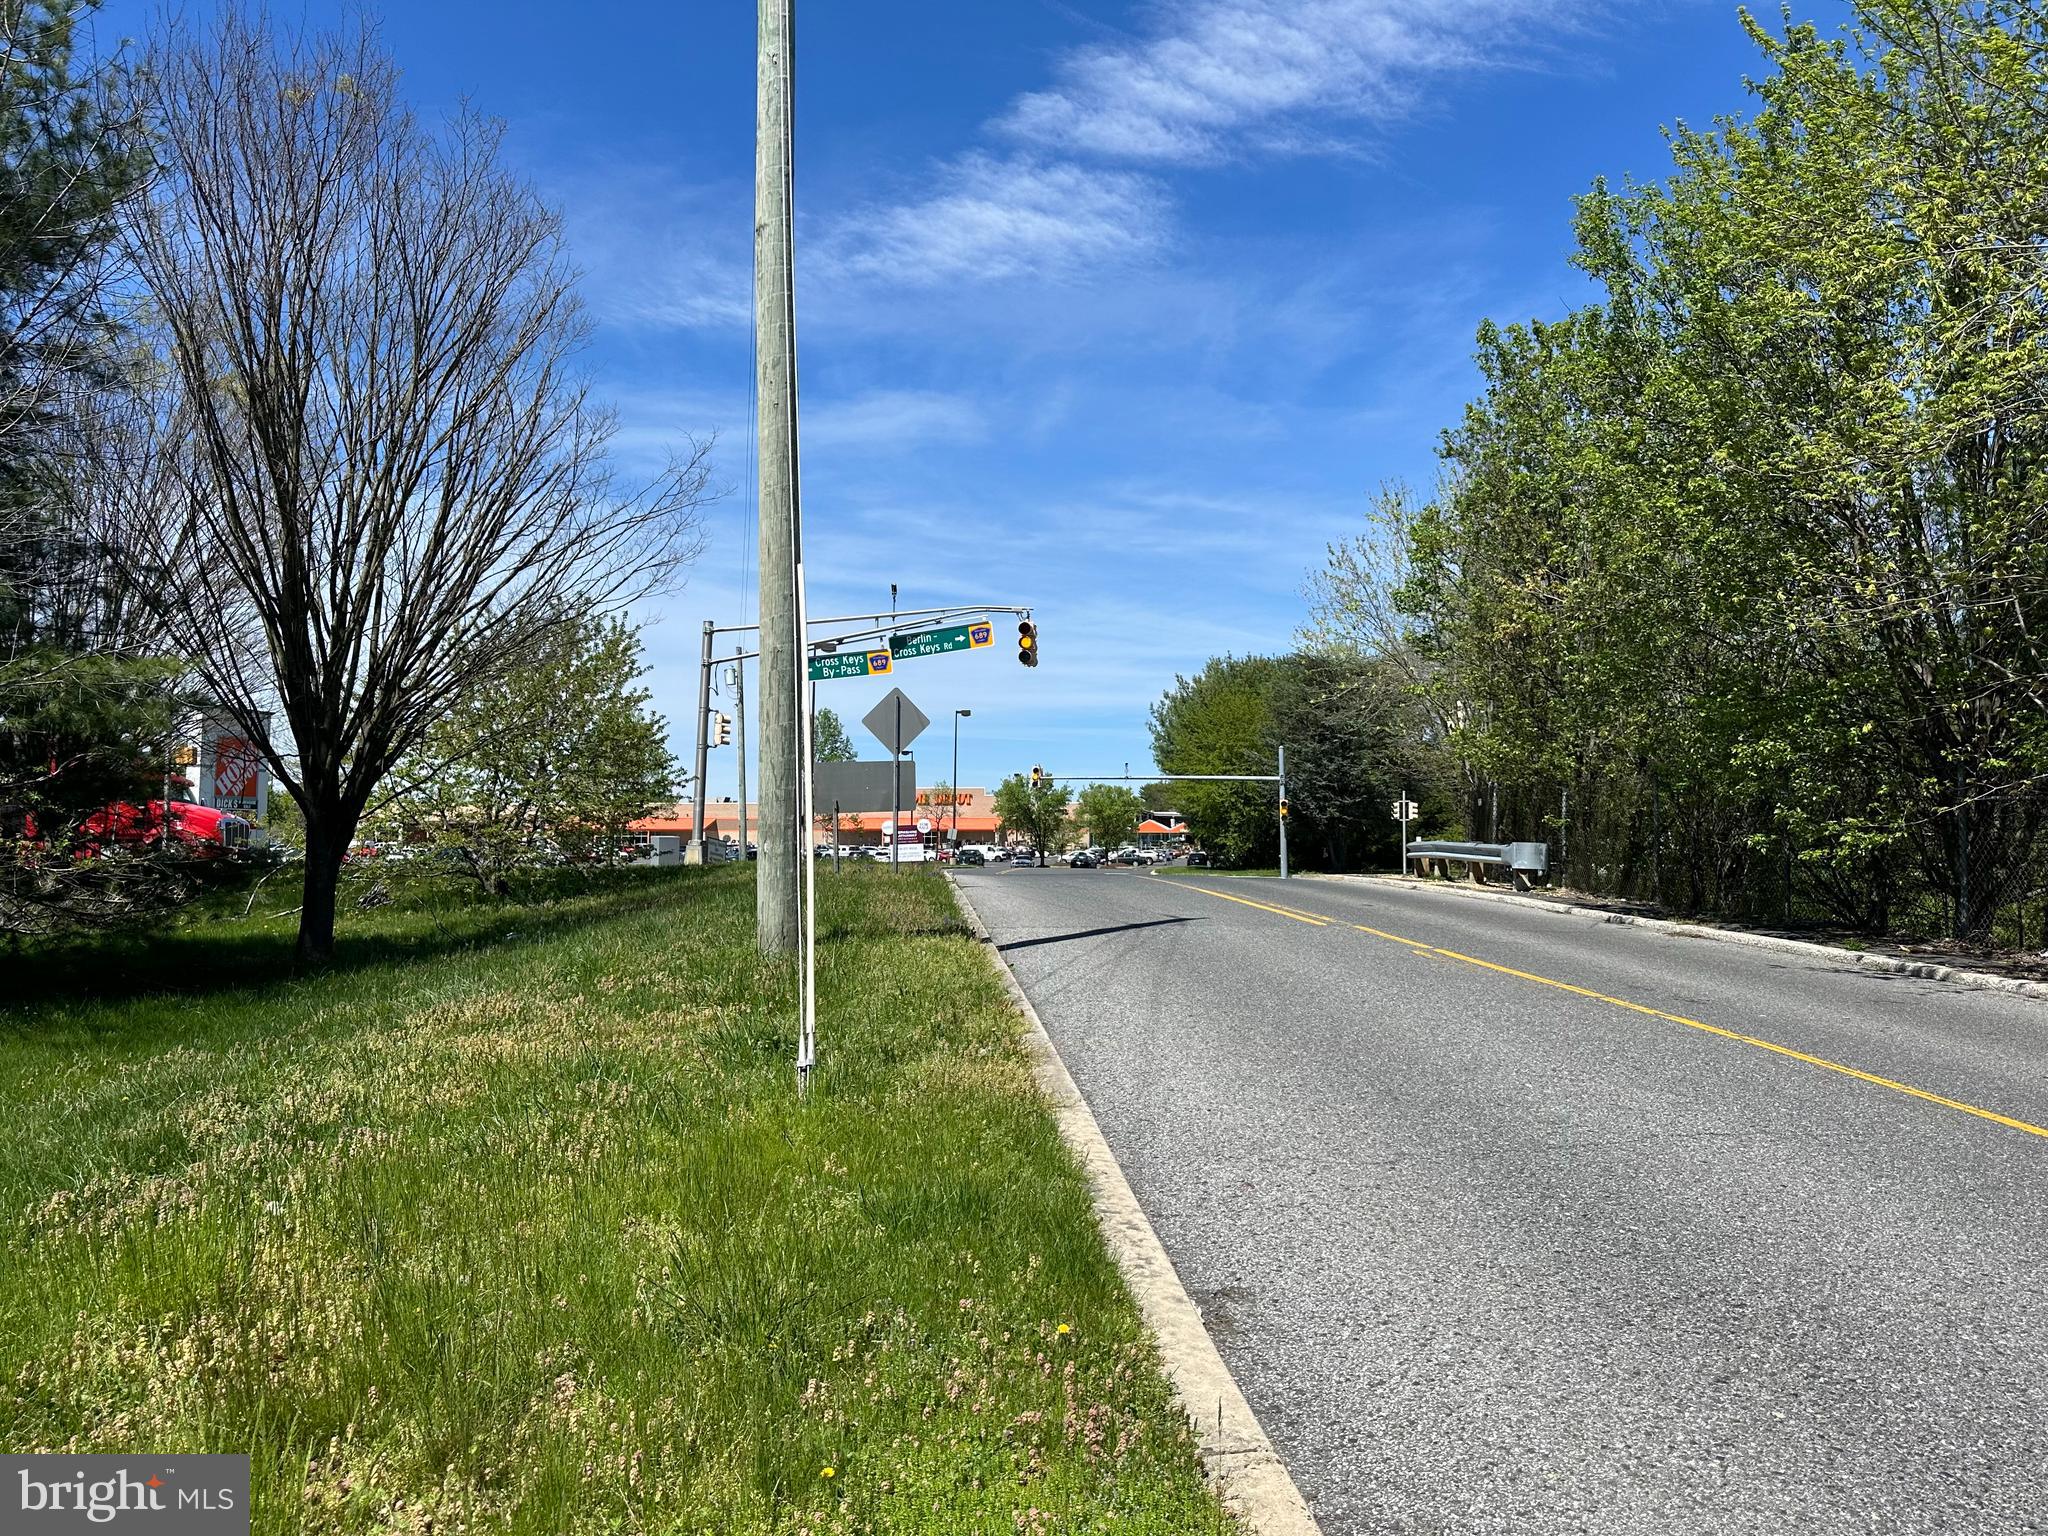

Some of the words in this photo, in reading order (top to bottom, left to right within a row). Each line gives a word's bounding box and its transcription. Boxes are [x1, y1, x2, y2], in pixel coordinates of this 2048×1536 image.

[974, 631, 988, 640] 689
[893, 647, 917, 658] Cross
[919, 643, 941, 654] Keys
[943, 642, 953, 650] Rd
[815, 656, 839, 667] Cross
[842, 655, 864, 666] Keys
[872, 658, 886, 667] 689
[822, 665, 861, 678] By-Pass
